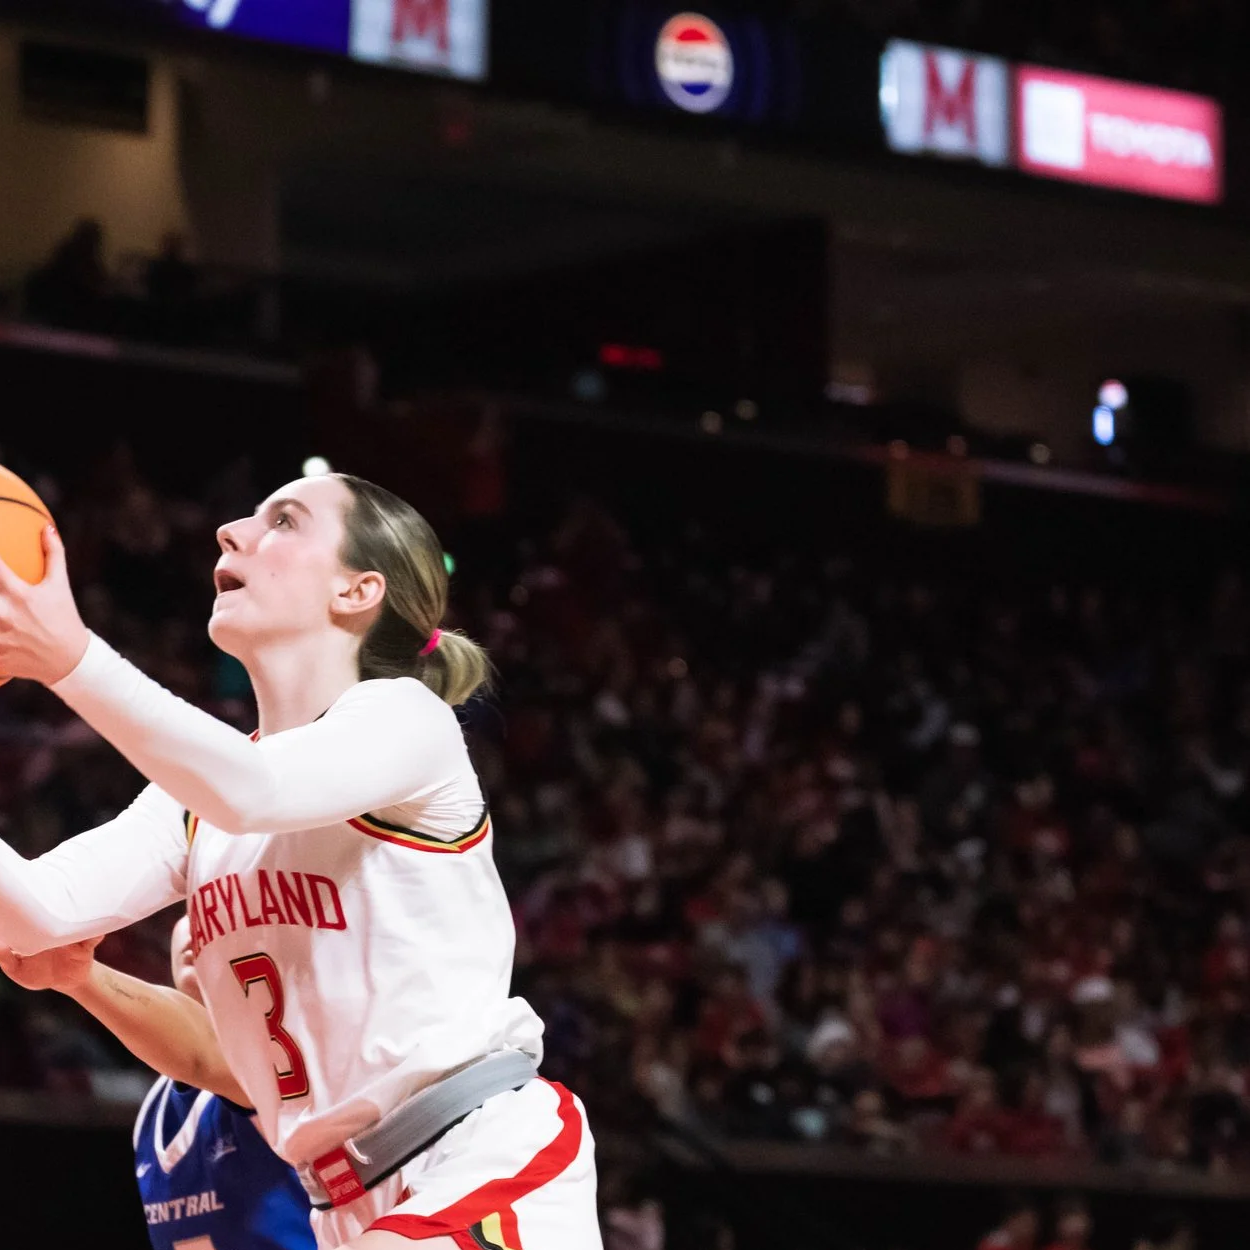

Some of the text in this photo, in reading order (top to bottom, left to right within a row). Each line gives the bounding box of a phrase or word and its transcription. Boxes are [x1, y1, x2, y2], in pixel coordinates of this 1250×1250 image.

[922, 49, 978, 147] M
[189, 868, 347, 960] ARYLAND
[229, 951, 310, 1101] 3
[144, 1190, 225, 1224] CENTRAL
